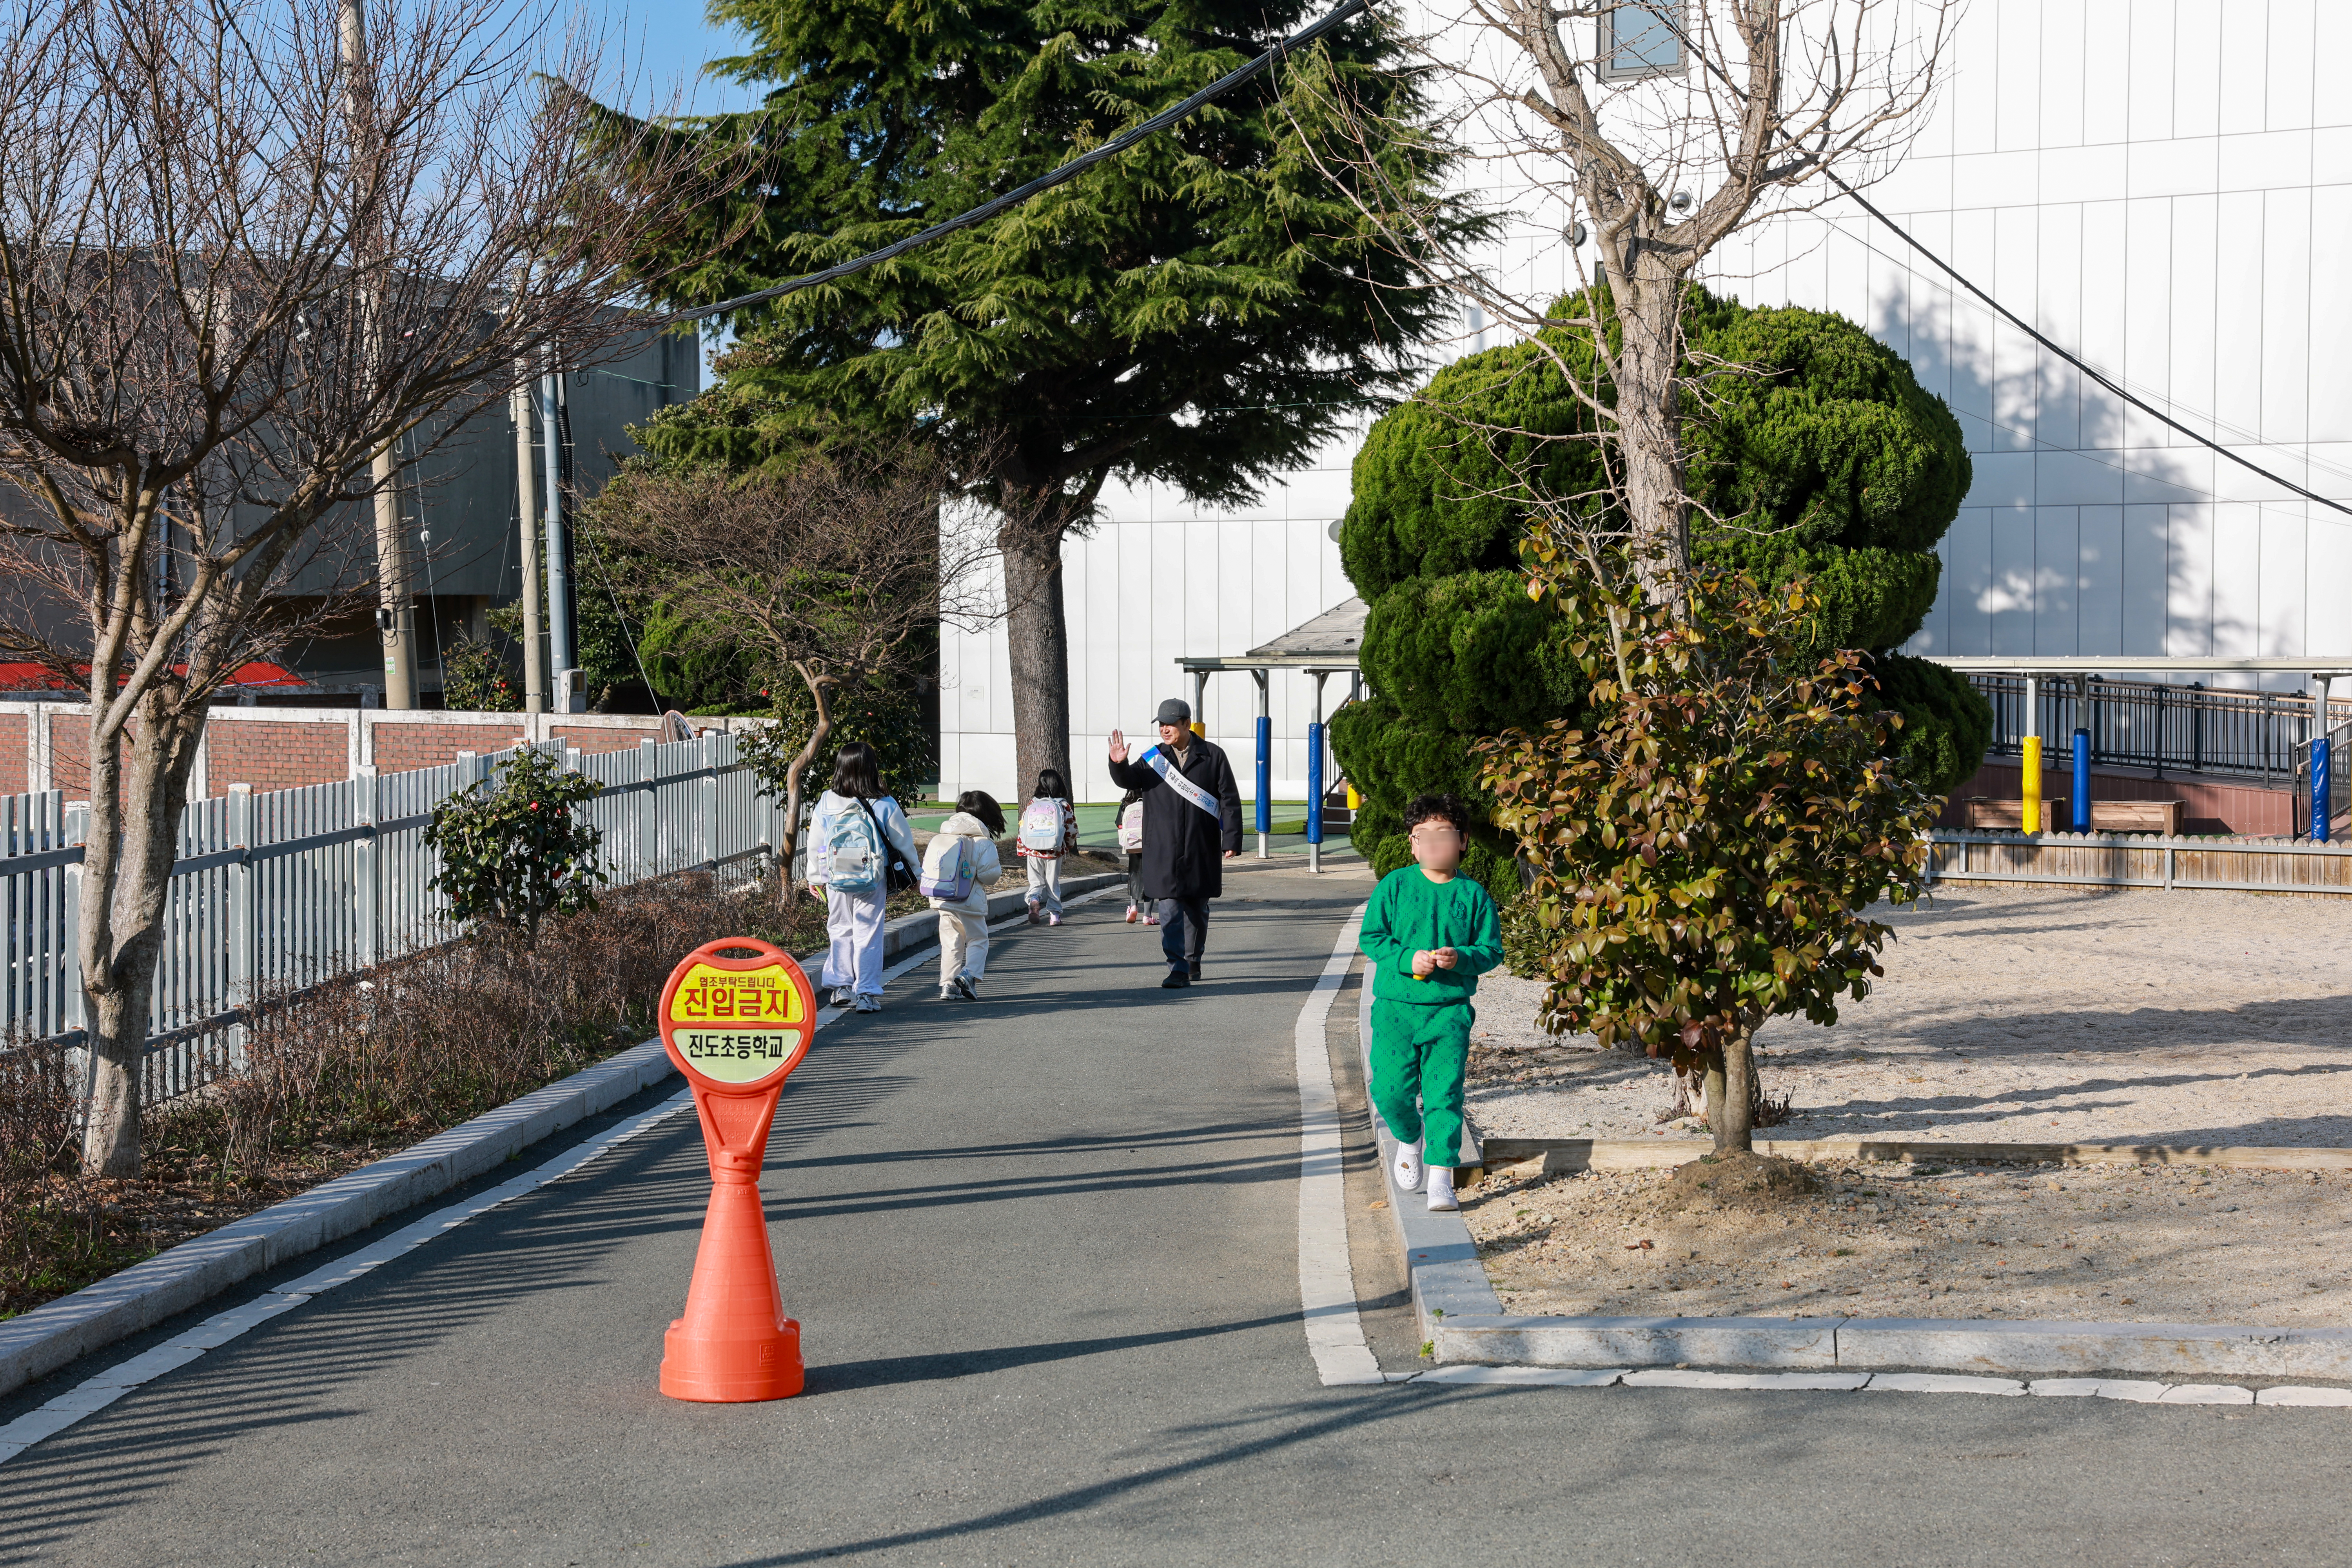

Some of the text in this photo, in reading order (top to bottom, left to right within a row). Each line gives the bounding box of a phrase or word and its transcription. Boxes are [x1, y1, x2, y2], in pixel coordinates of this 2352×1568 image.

[1178, 781, 1195, 796] 위험요소
[699, 976, 775, 988] 협조부탁드립니다
[684, 988, 789, 1018] 진입금지
[689, 1034, 783, 1059] 진도초등학교
